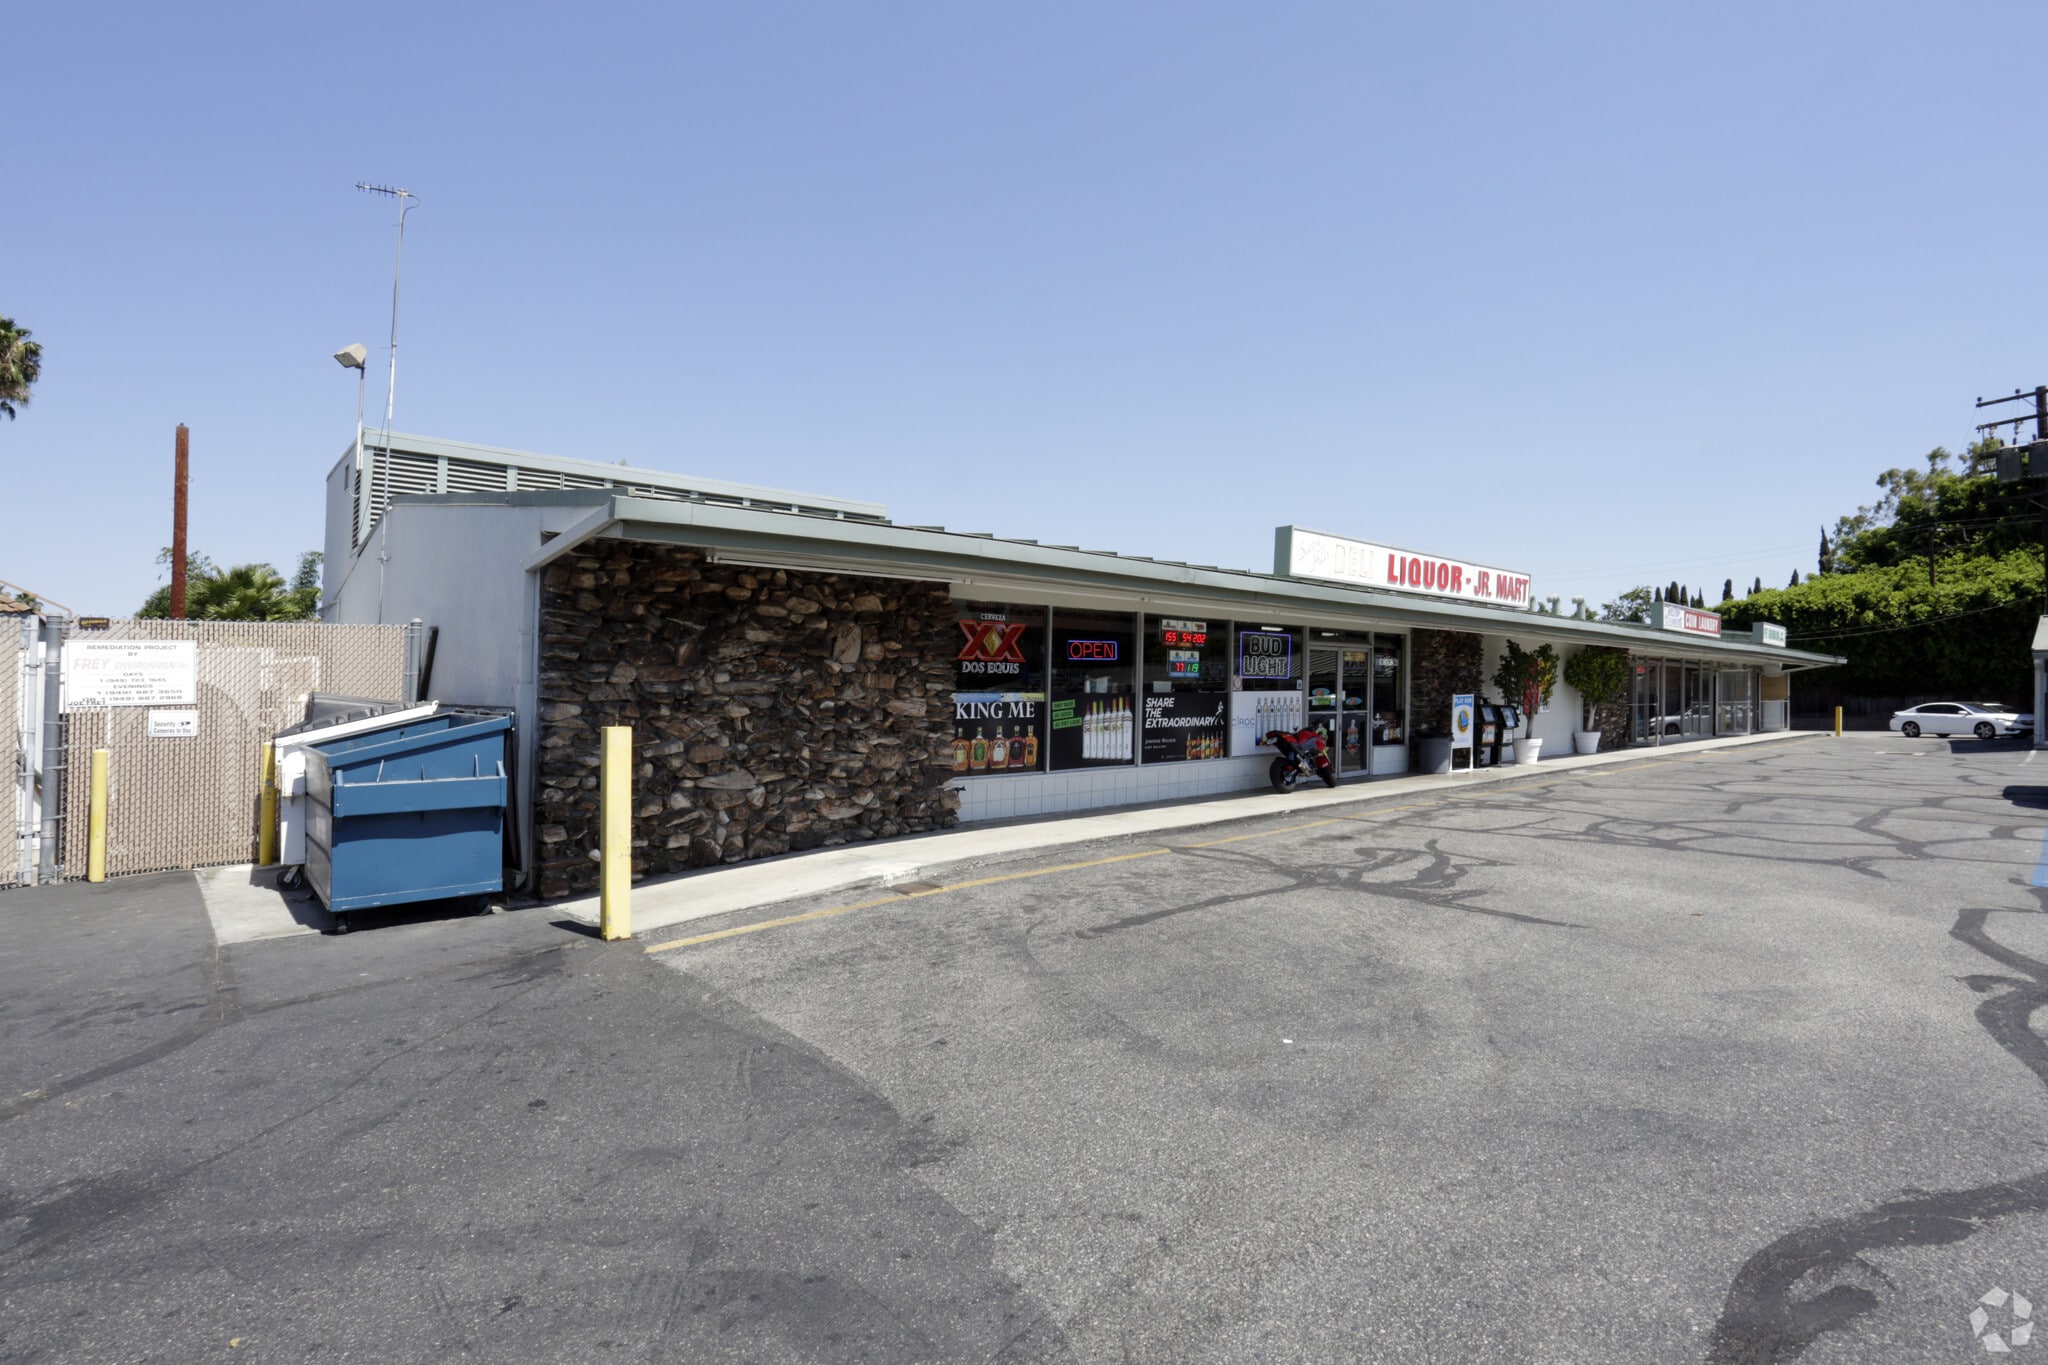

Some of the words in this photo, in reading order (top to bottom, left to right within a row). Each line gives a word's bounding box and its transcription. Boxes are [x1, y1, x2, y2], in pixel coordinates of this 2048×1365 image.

[1334, 543, 1375, 579] DELI
[1387, 553, 1463, 593] LIQUOR
[1474, 570, 1492, 597] JR.
[1496, 573, 1529, 602] MART
[981, 613, 1006, 621] CERVEZA
[1165, 632, 1177, 642] 155
[1182, 633, 1192, 643] 54
[1192, 633, 1207, 643] 202
[1069, 642, 1114, 658] OPEN
[1249, 635, 1282, 656] BUD
[73, 658, 110, 670] FREY
[114, 661, 190, 670] ENVIRONMENTAL
[962, 661, 985, 673] DOS
[987, 662, 1020, 674] EQUIS
[1243, 655, 1287, 676] LIGHT
[1145, 697, 1175, 708] SHARE
[955, 701, 1003, 719] KING
[1008, 701, 1035, 718] ME
[1145, 707, 1163, 718] THE
[1145, 716, 1216, 728] EXTRAORDINARY
